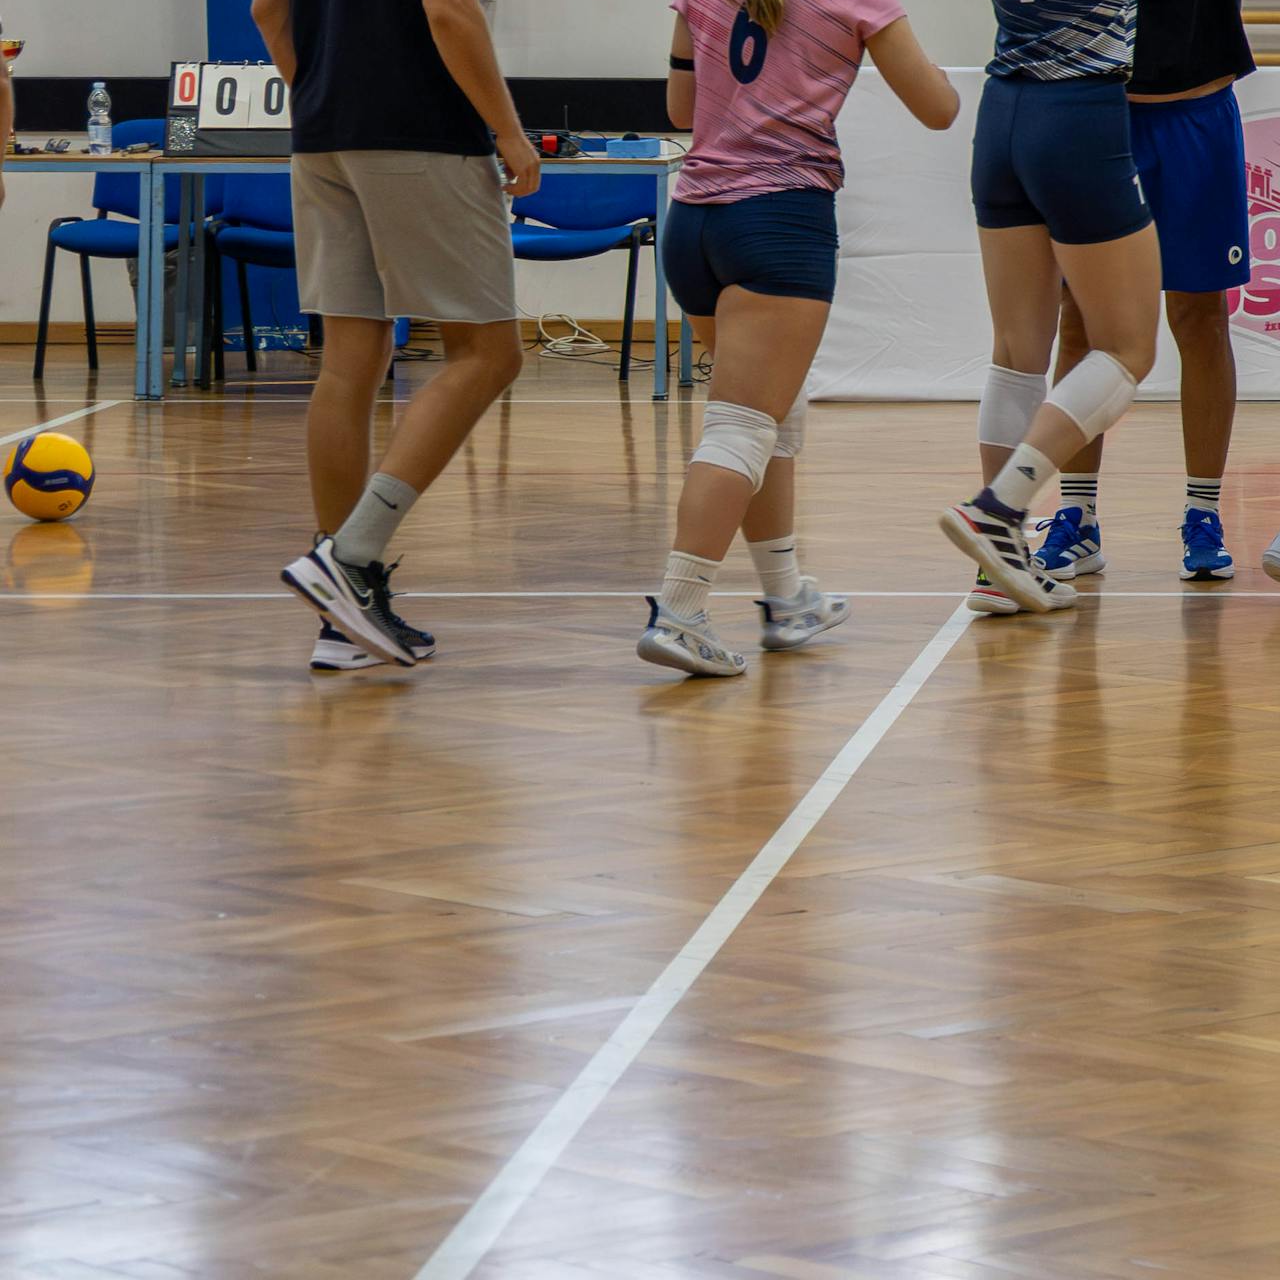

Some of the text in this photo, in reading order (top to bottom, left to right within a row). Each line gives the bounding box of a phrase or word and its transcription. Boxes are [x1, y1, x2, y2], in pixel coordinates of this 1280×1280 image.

[729, 5, 768, 85] 6
[179, 71, 196, 103] 0
[215, 76, 285, 116] 0 0
